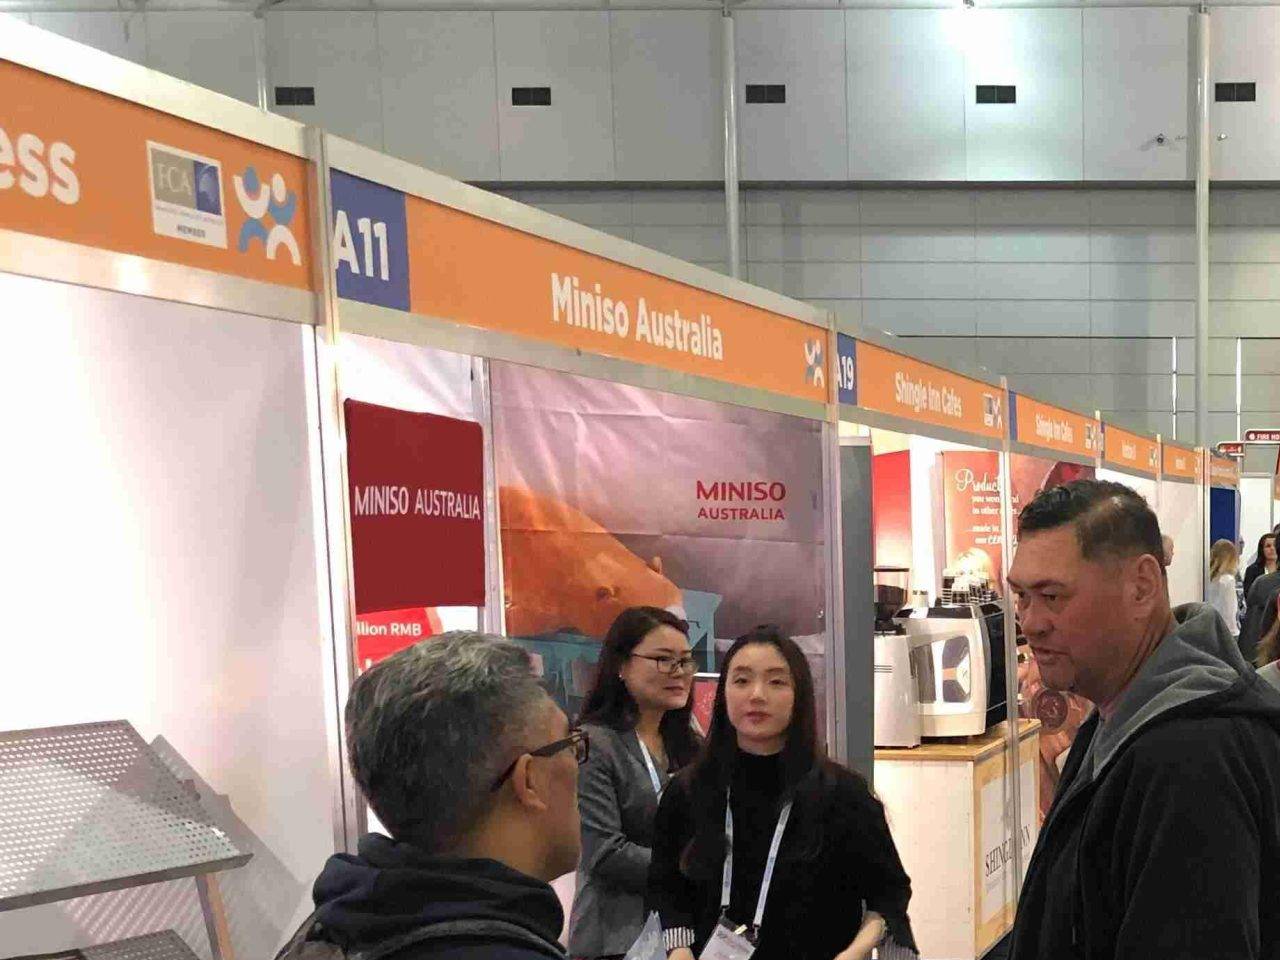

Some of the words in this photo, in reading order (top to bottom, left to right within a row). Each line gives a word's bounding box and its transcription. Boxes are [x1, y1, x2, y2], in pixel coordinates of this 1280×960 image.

[334, 209, 390, 281] A11
[551, 272, 630, 338] Miniso
[635, 297, 724, 361] Australia
[354, 484, 409, 516] MINISO
[414, 488, 481, 520] AUSTRALIA
[696, 480, 786, 501] MINISO
[697, 507, 785, 520] AUSTRALIA
[390, 623, 422, 636] RMB
